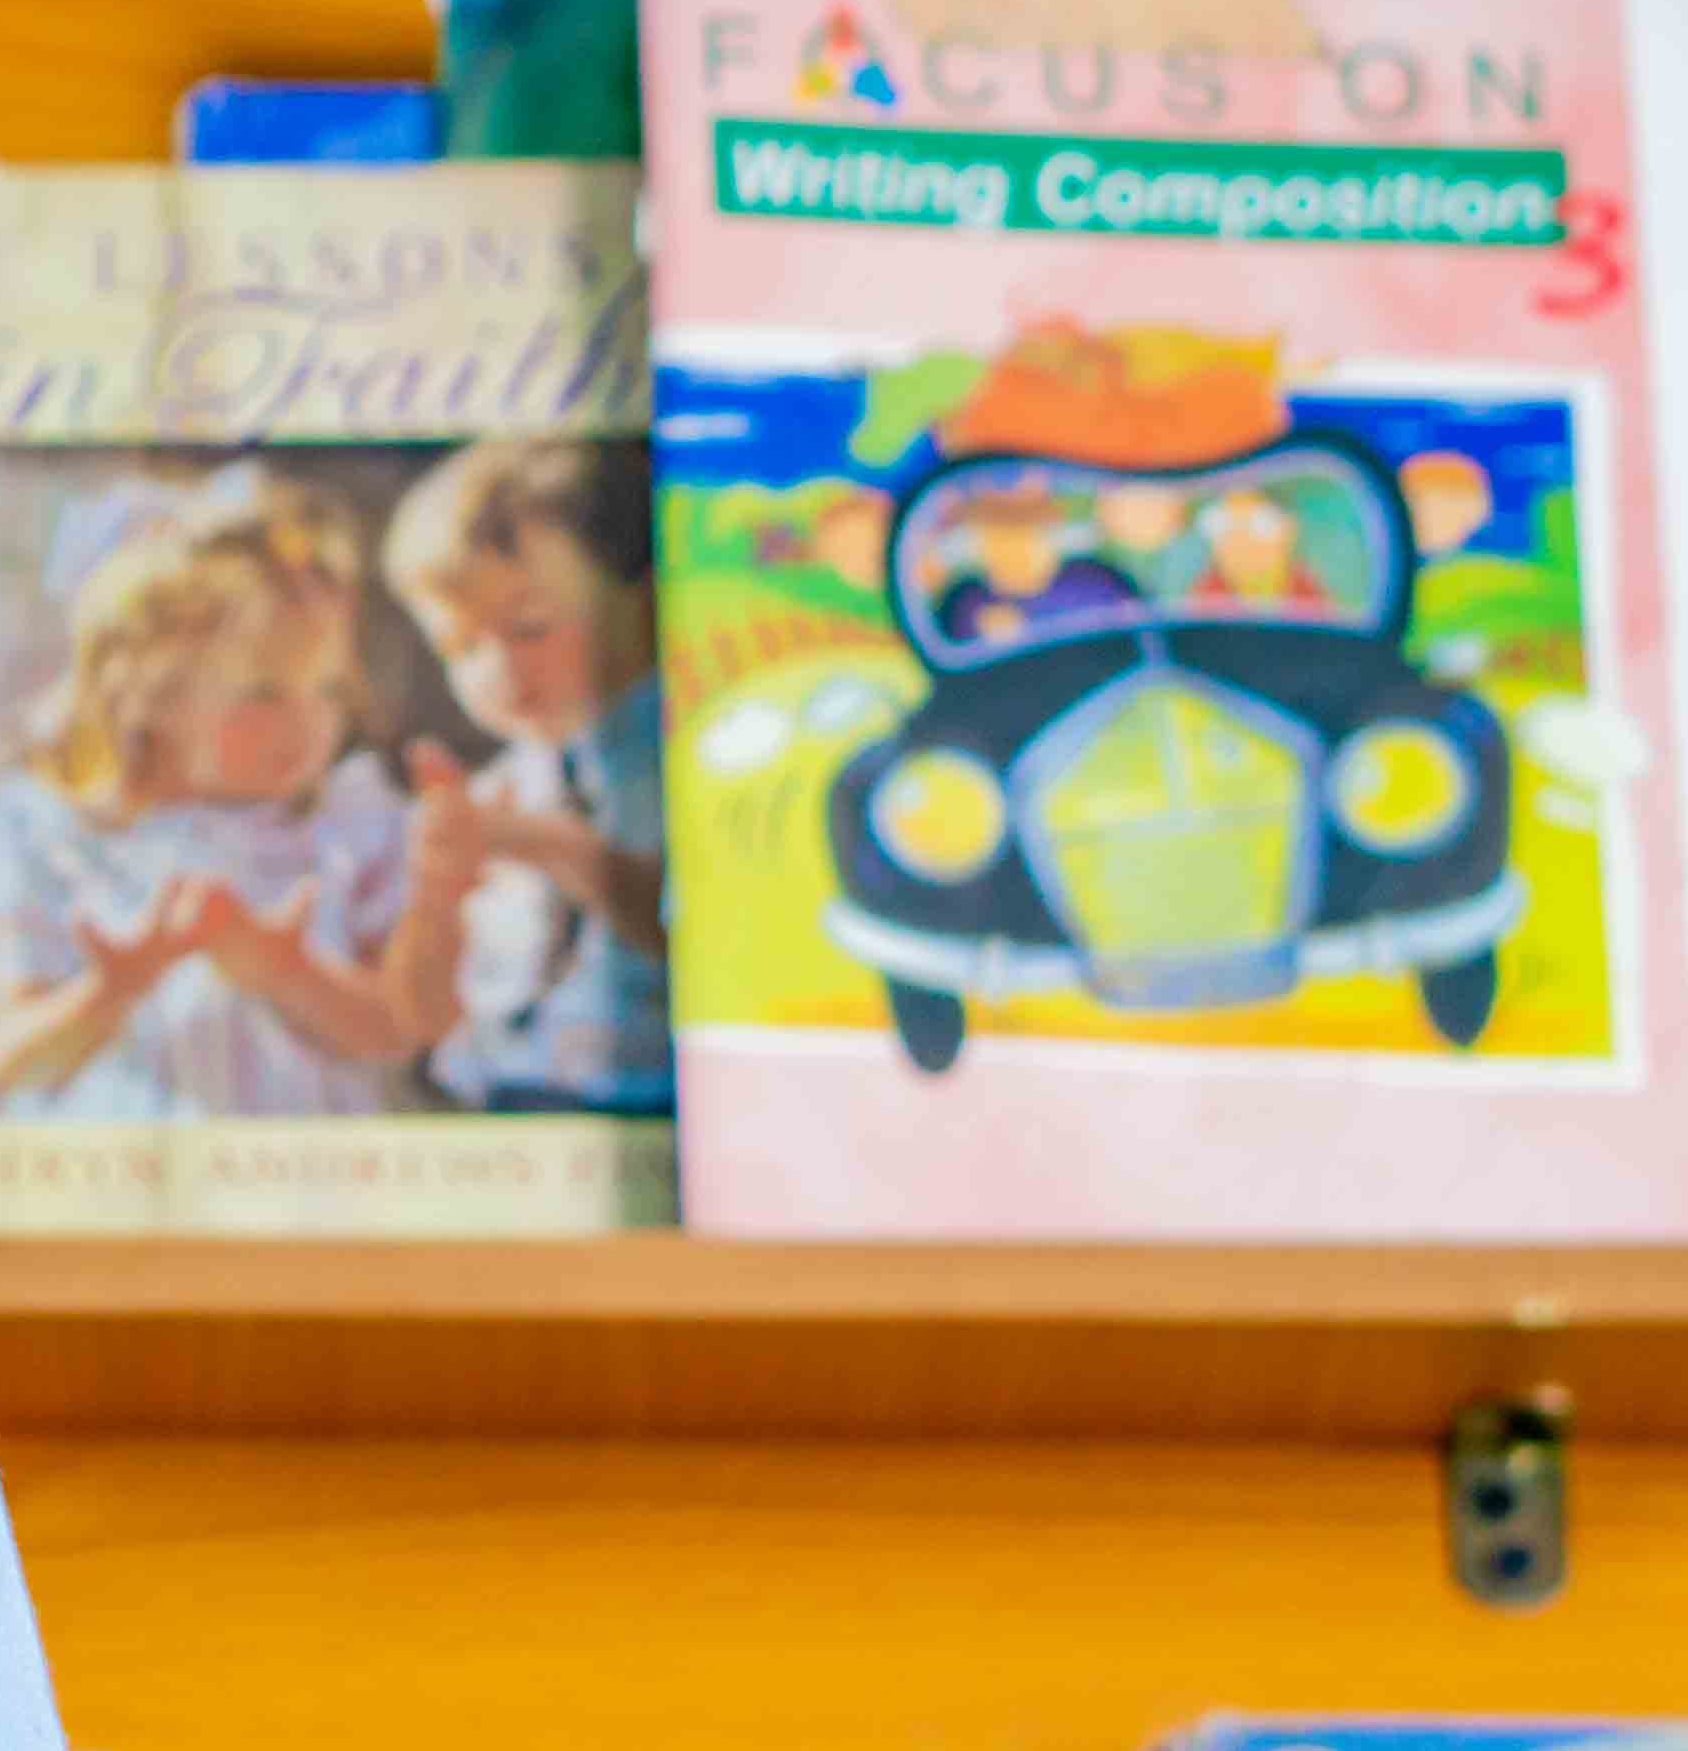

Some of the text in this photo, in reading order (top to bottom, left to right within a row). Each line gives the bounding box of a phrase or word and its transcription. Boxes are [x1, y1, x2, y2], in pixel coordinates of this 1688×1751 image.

[1334, 39, 1547, 123] ON
[728, 135, 1557, 242] Writing Composition
[91, 225, 605, 297] LESSONS
[1527, 185, 1625, 321] 3
[159, 270, 651, 456] Faith
